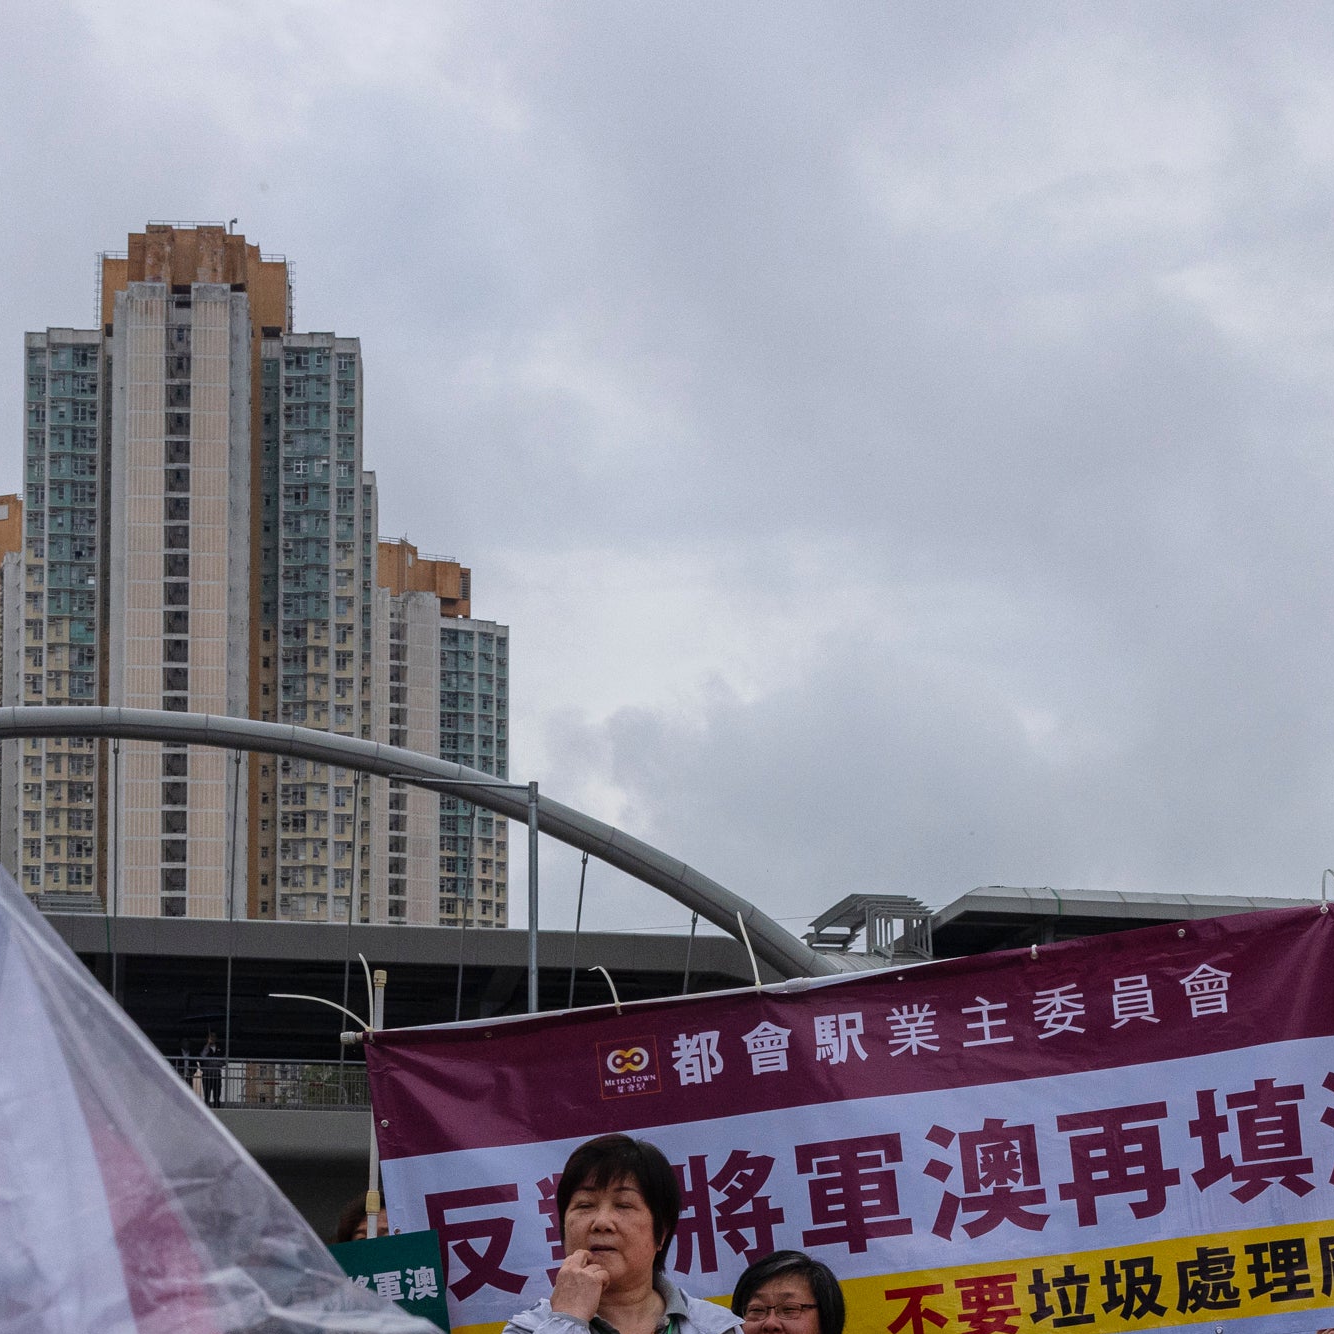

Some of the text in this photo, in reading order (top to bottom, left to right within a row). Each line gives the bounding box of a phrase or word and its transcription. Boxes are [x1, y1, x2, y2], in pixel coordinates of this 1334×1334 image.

[671, 963, 1234, 1087] 都會駅業主委員會
